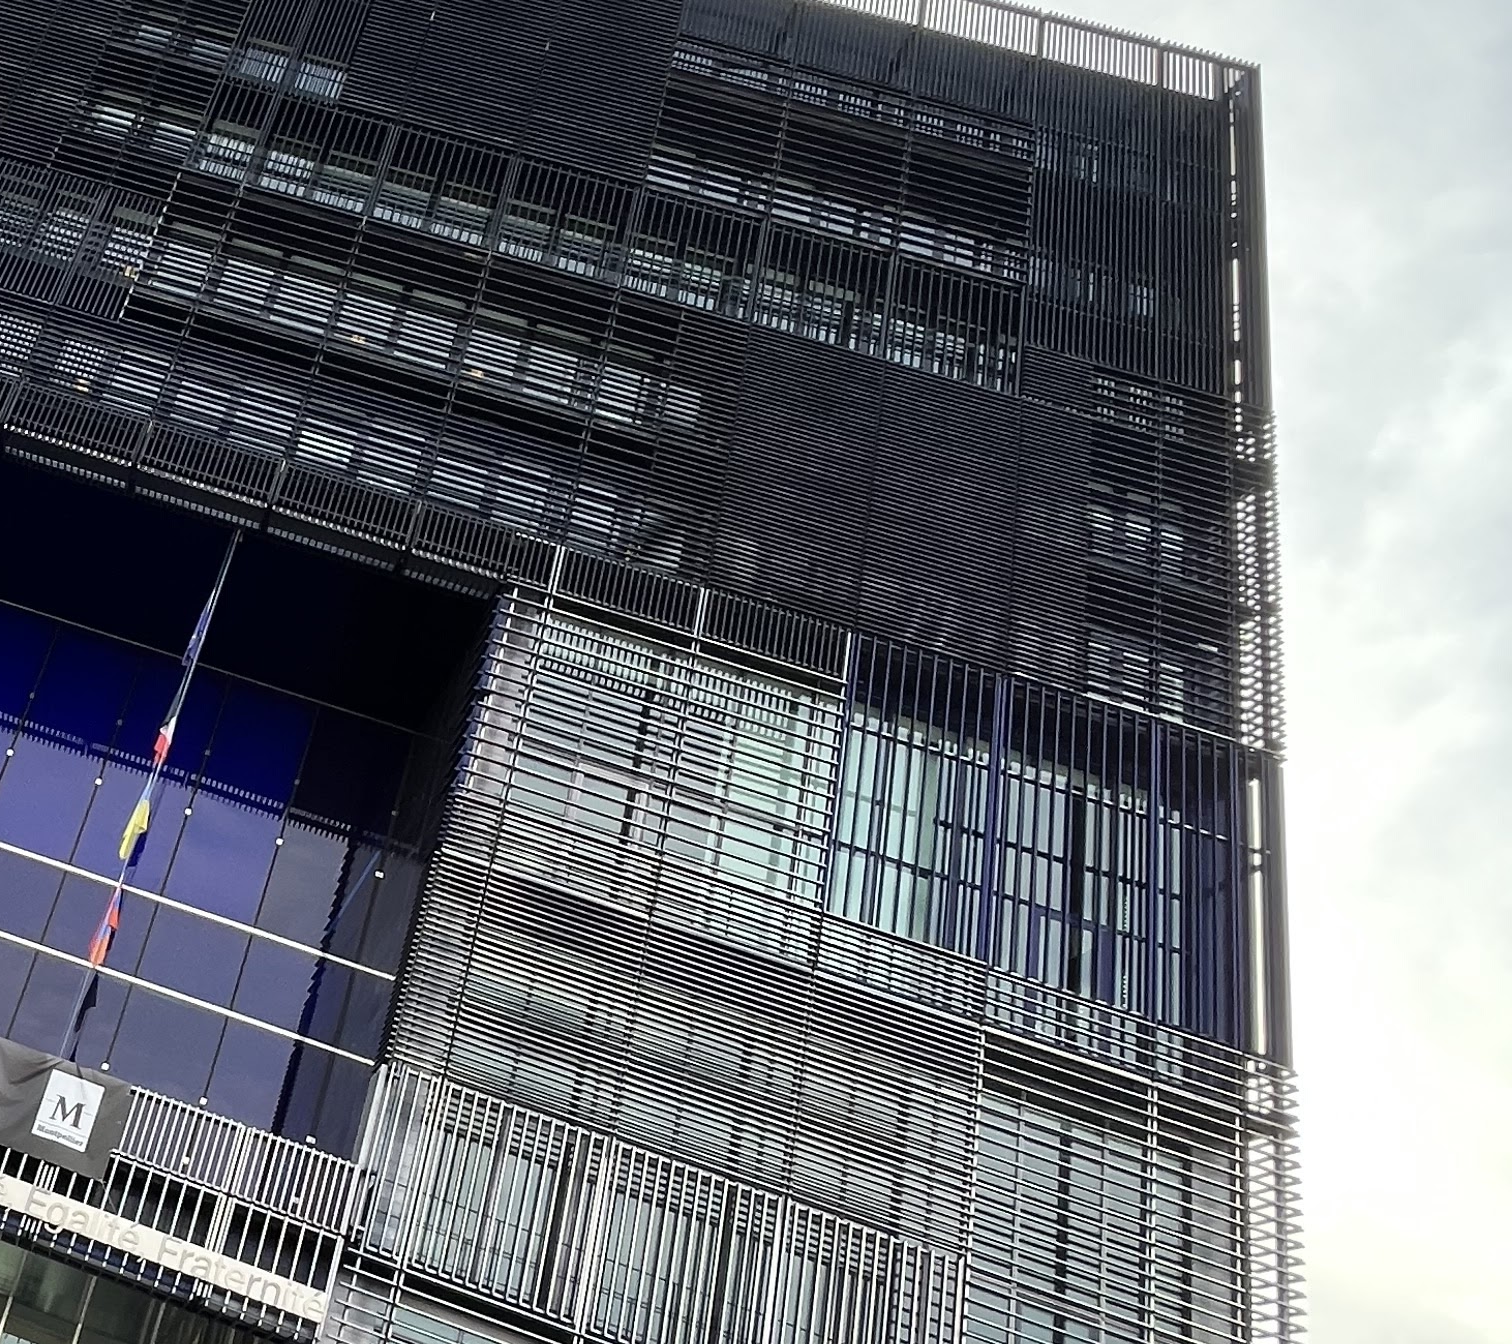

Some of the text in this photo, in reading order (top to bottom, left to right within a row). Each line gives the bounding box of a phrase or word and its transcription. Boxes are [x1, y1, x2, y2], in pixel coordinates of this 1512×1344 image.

[49, 1093, 87, 1130] M
[36, 1123, 84, 1147] Montpellier
[157, 1235, 326, 1320] Fraternité
